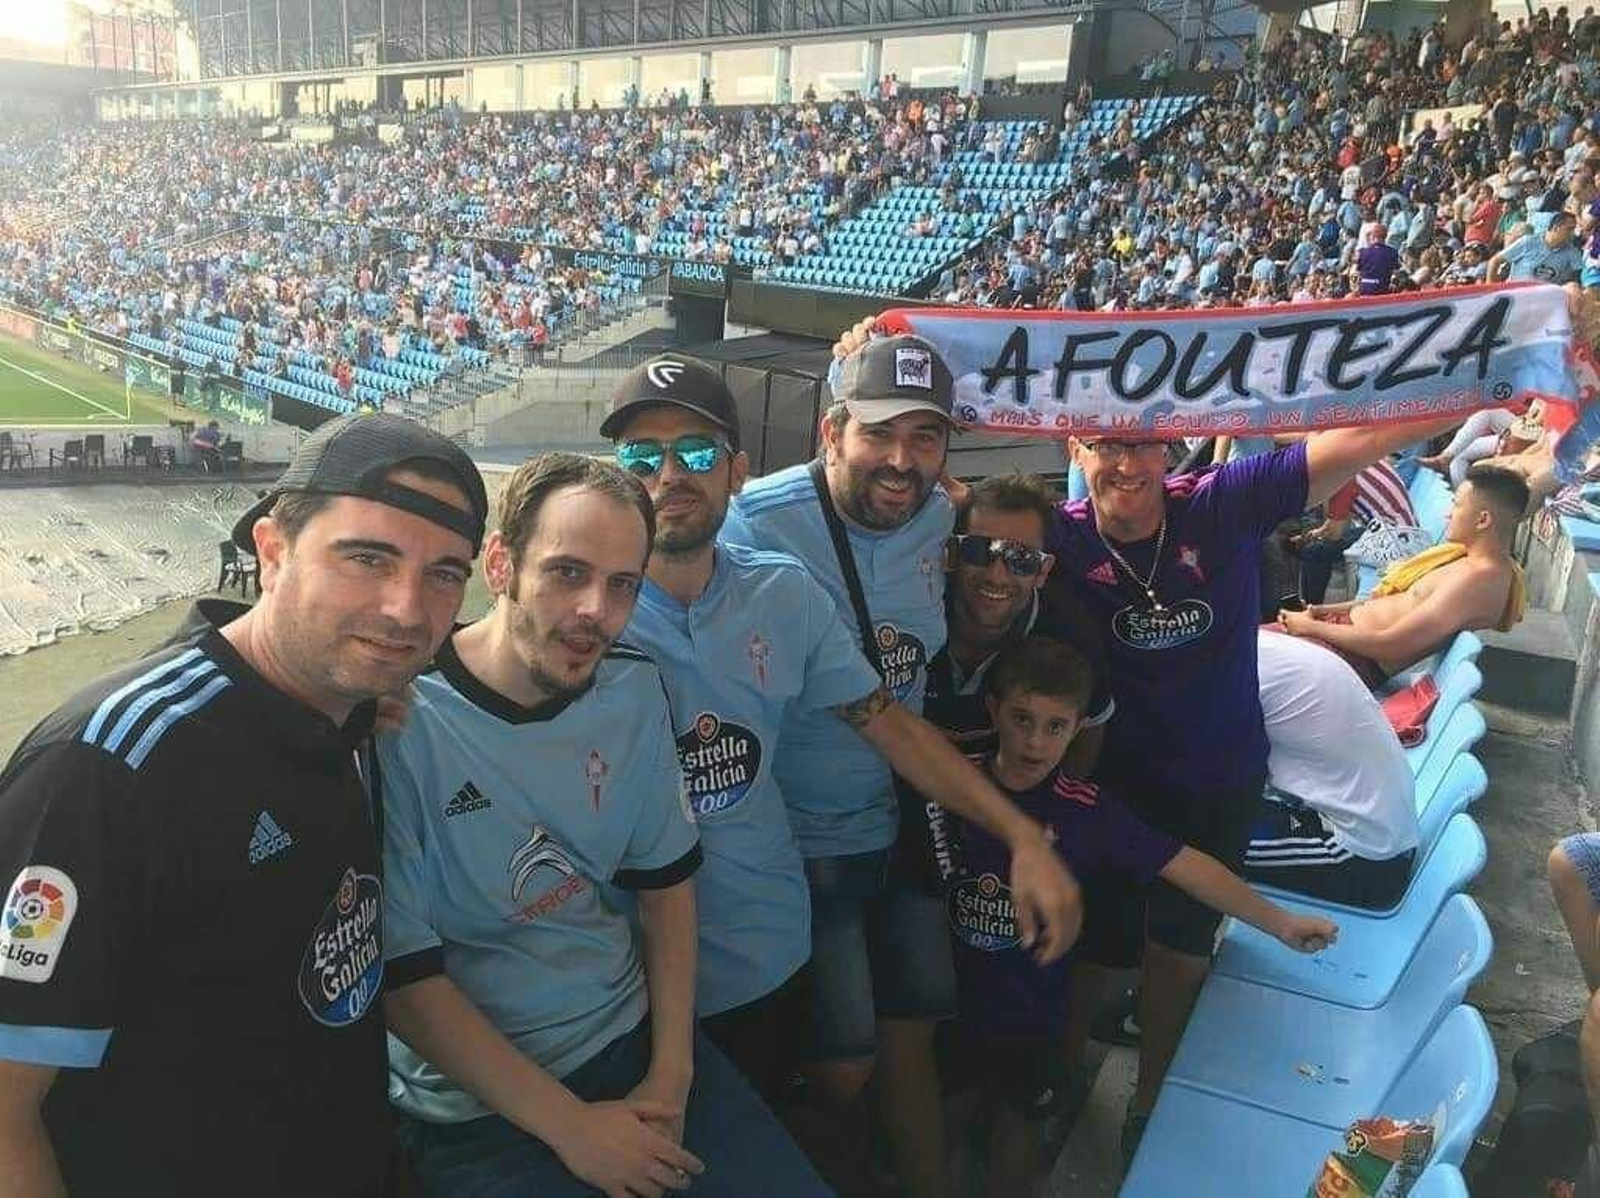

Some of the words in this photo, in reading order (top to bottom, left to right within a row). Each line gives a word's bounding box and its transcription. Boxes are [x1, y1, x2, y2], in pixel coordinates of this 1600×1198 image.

[981, 325, 1039, 401] A
[1053, 297, 1511, 401] FOUTEZA
[1055, 413, 1100, 428] QUE
[1111, 414, 1143, 429] UN
[1267, 410, 1304, 426] UN
[683, 760, 746, 794] alicia
[444, 798, 492, 818] adidas
[249, 832, 292, 863] adidas
[313, 898, 377, 971] Estrella
[321, 934, 379, 1002] Galicia
